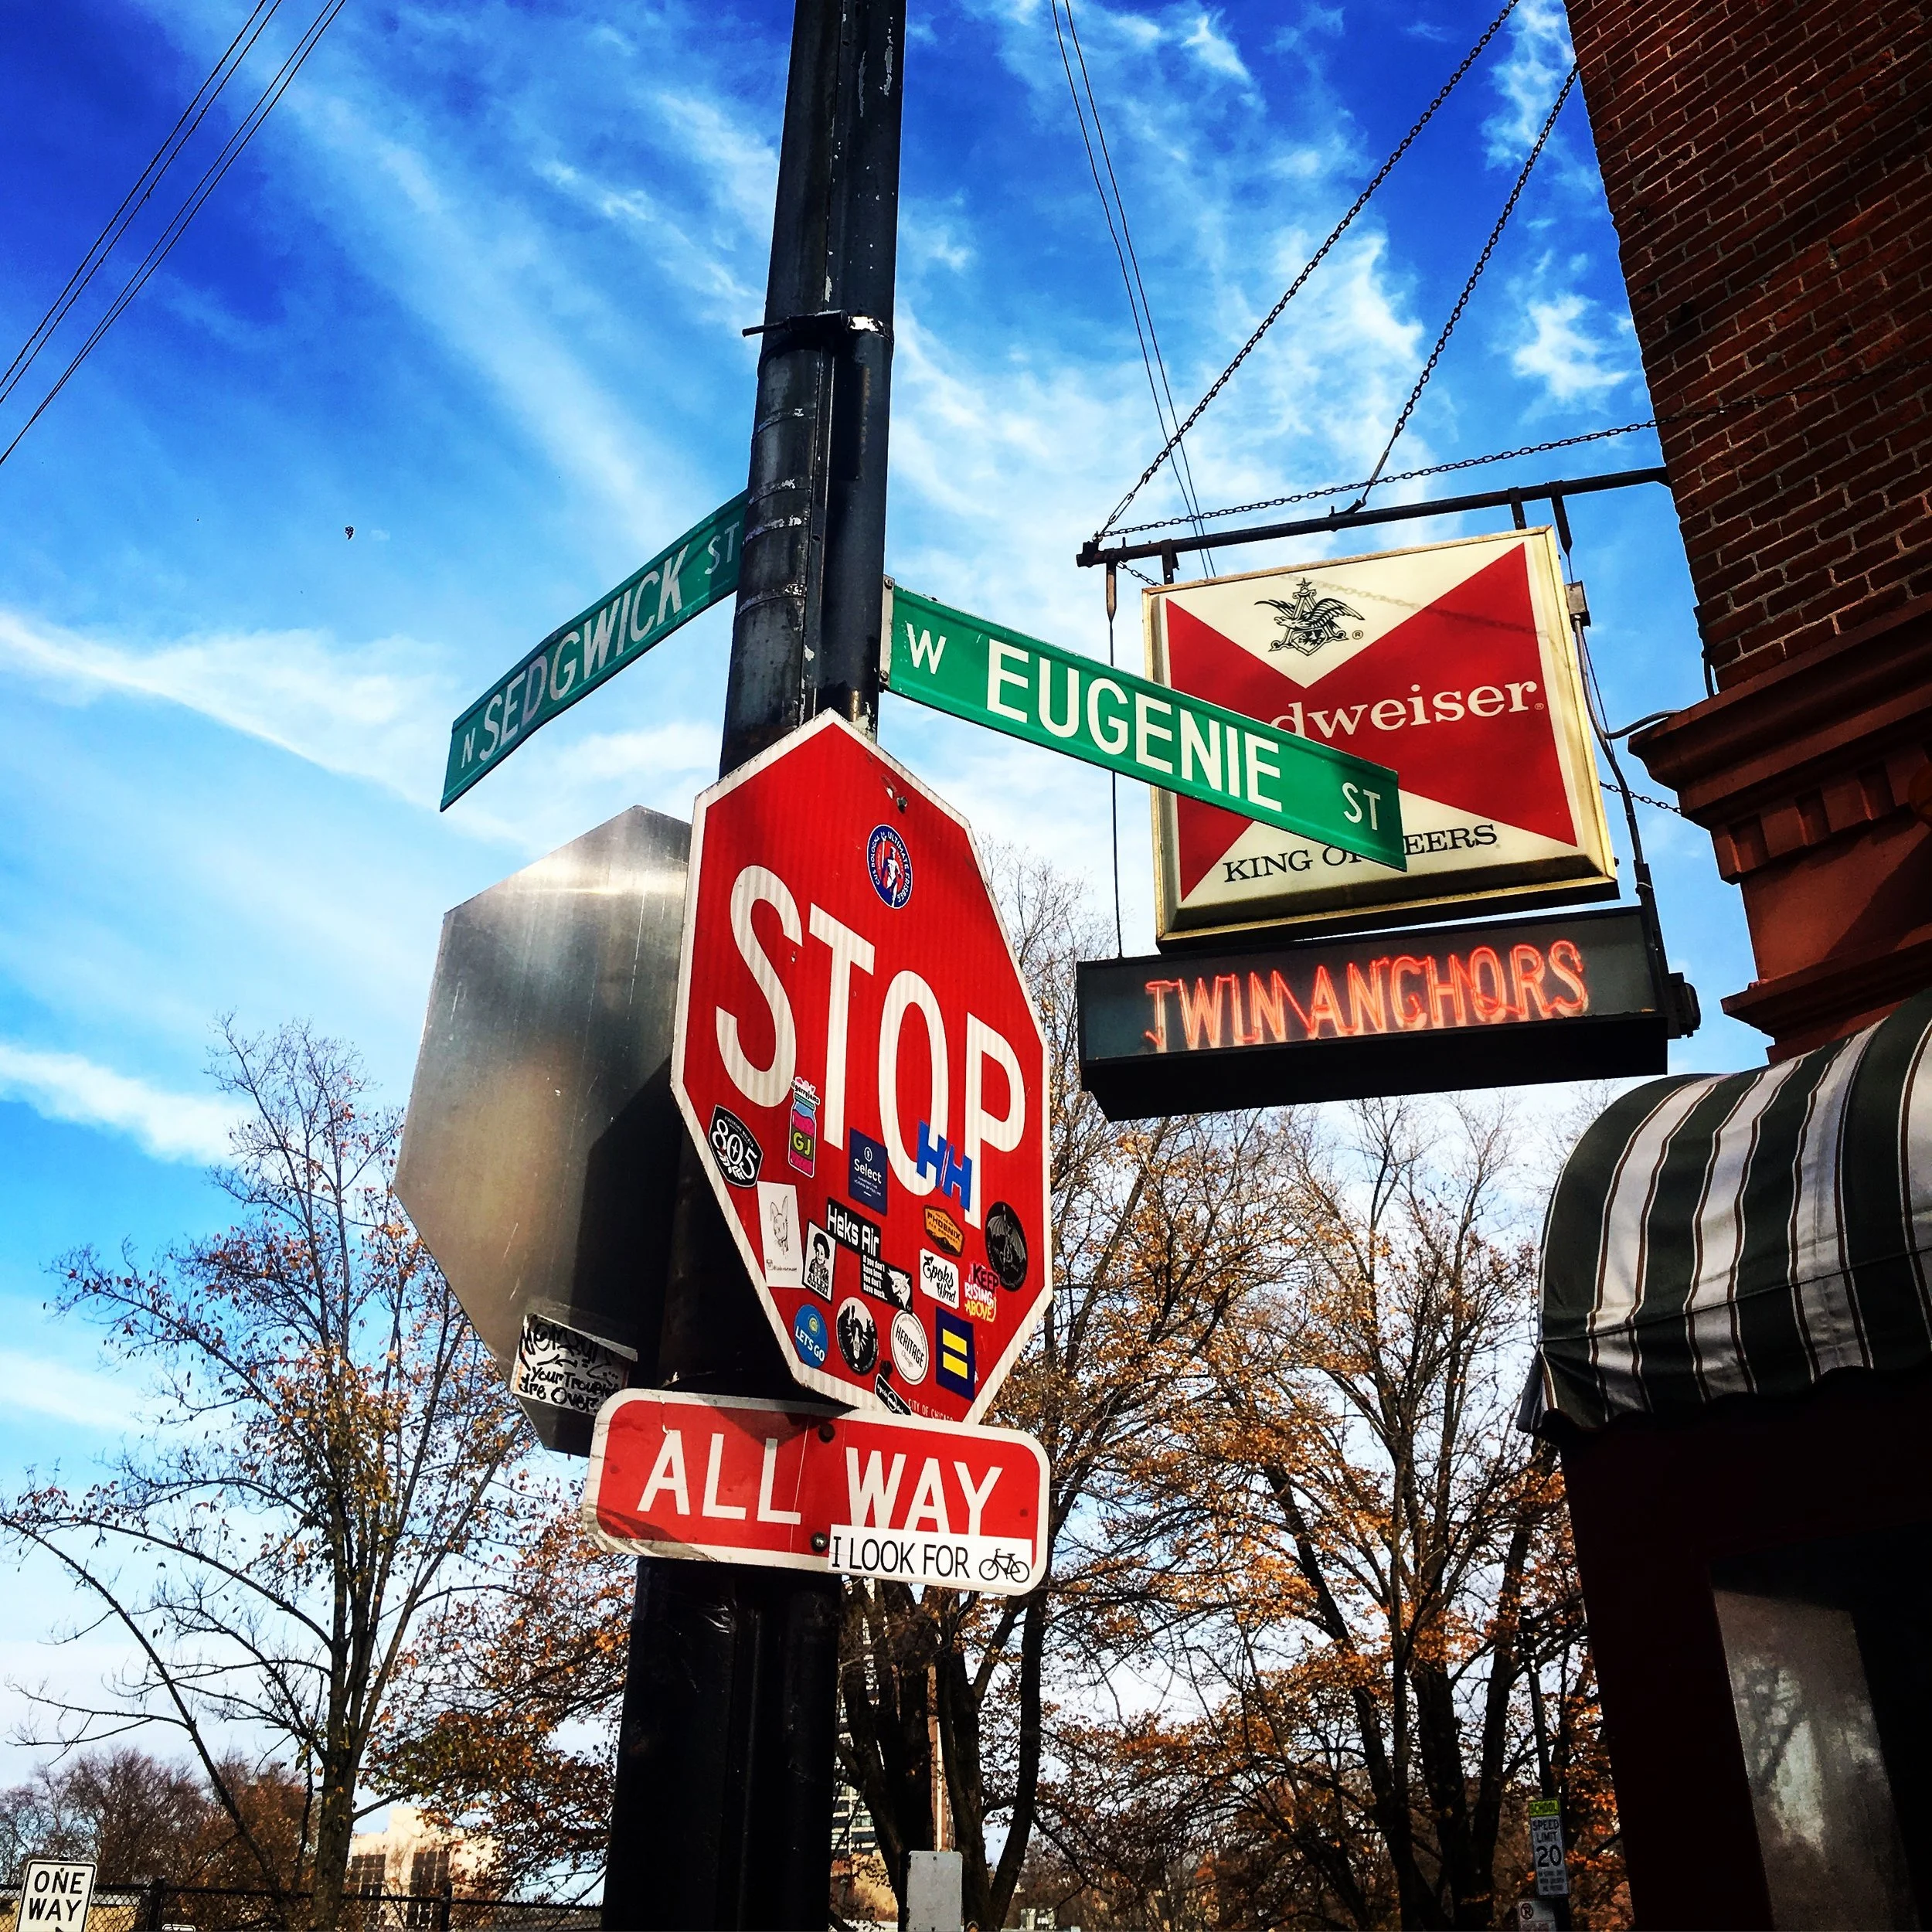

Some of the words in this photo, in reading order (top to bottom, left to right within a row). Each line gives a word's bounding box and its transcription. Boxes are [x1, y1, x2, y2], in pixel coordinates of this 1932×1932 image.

[461, 728, 476, 768] N
[479, 544, 689, 761] SEDGWICK
[705, 522, 740, 575] ST
[905, 621, 947, 675] W
[987, 639, 1282, 812] EUGENIE
[1342, 782, 1380, 831] ST
[1270, 679, 1537, 740] dweiser
[887, 831, 909, 869] ULTIMATE
[1223, 850, 1314, 883] KING
[1403, 825, 1498, 855] EERS
[897, 872, 910, 903] FRISBEE
[1145, 970, 1290, 1053] TWIN
[1309, 939, 1590, 1039] ANCHORS
[716, 866, 1026, 1230] STOP
[713, 1119, 757, 1179] 805
[793, 1132, 811, 1155] GJ
[854, 1158, 882, 1184] Select
[916, 1120, 973, 1212] HH
[828, 1204, 859, 1246] Heks
[862, 1225, 879, 1257] Air
[927, 1212, 960, 1239] PHOENIX
[964, 1282, 995, 1308] RISING
[972, 1263, 1000, 1294] KEEP
[964, 1300, 995, 1323] ABOVE
[795, 1325, 814, 1351] LET'S
[814, 1345, 825, 1362] GO
[895, 1324, 924, 1368] HERITAGE
[908, 1398, 920, 1412] CITY
[922, 1404, 929, 1416] OF
[638, 1430, 801, 1525] ALL
[845, 1446, 1003, 1536] WAY
[832, 1536, 842, 1568] I
[849, 1538, 917, 1574] LOOK
[923, 1544, 971, 1579] FOR
[1532, 1819, 1560, 1832] SPEED
[1536, 1832, 1558, 1843] LIMIT
[1536, 1845, 1562, 1868] 20
[34, 1870, 85, 1894] ONE
[29, 1898, 82, 1922] WAY
